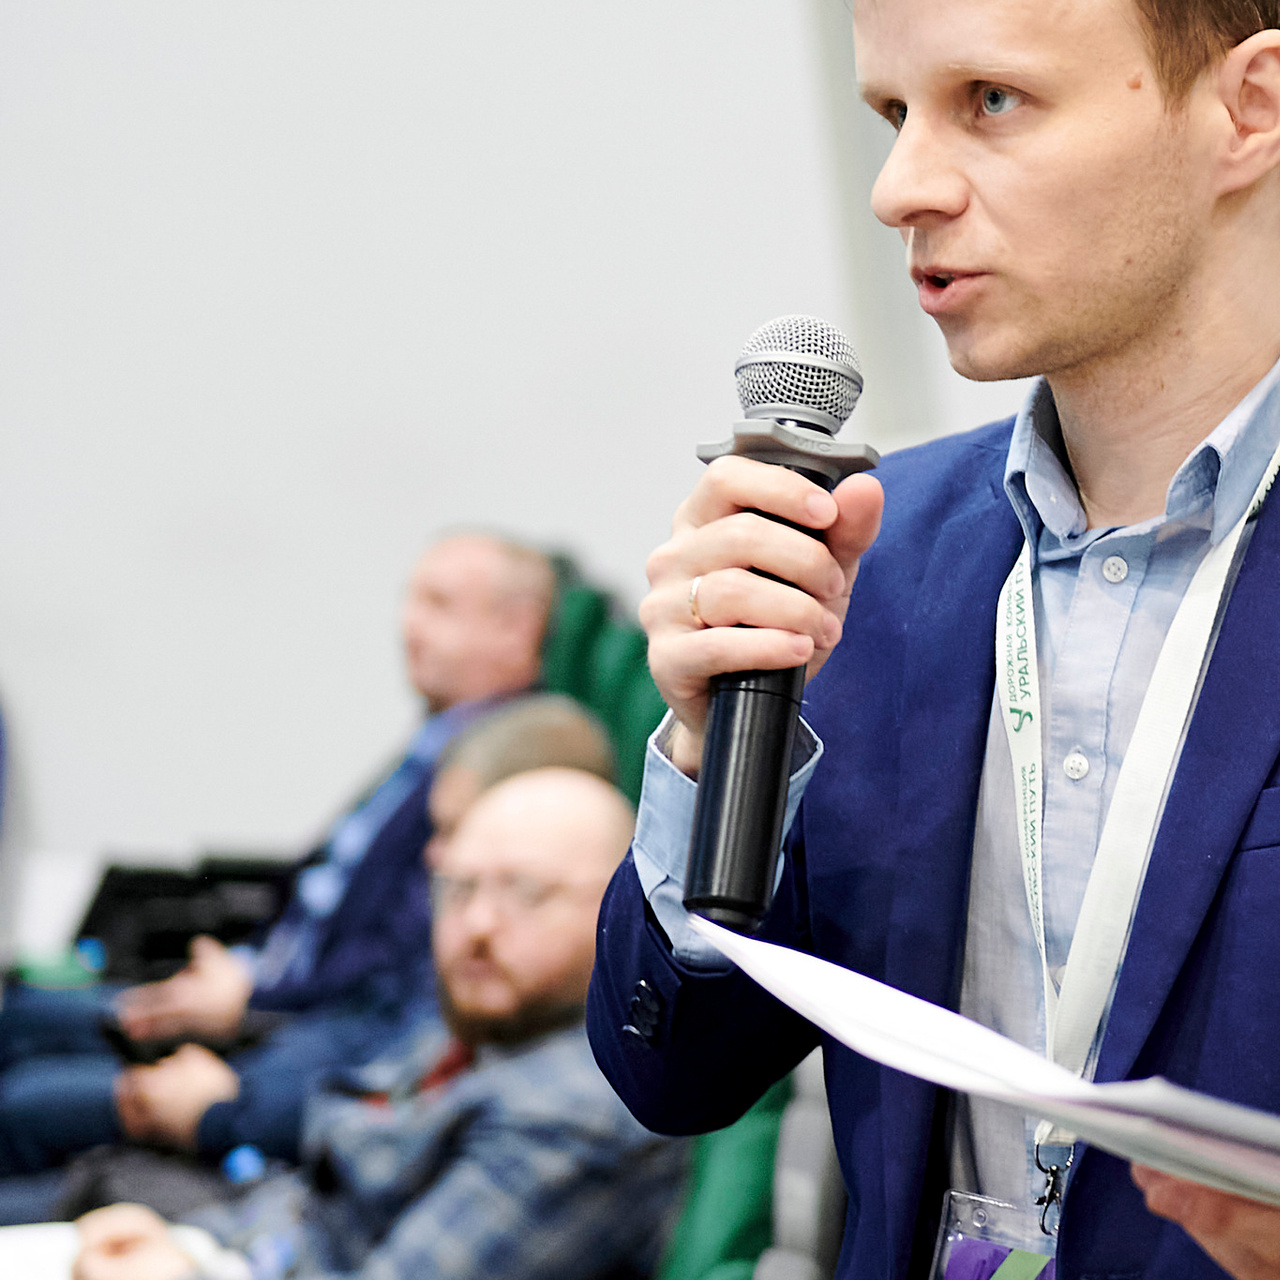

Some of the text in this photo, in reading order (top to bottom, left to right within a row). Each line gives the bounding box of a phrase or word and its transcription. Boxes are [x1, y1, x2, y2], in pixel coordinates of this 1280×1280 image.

[1006, 633, 1017, 702] ДОРОЖНАЯ
[1015, 588, 1031, 701] УРАЛЬСКИЙ
[1028, 763, 1036, 814] ПУТЬ
